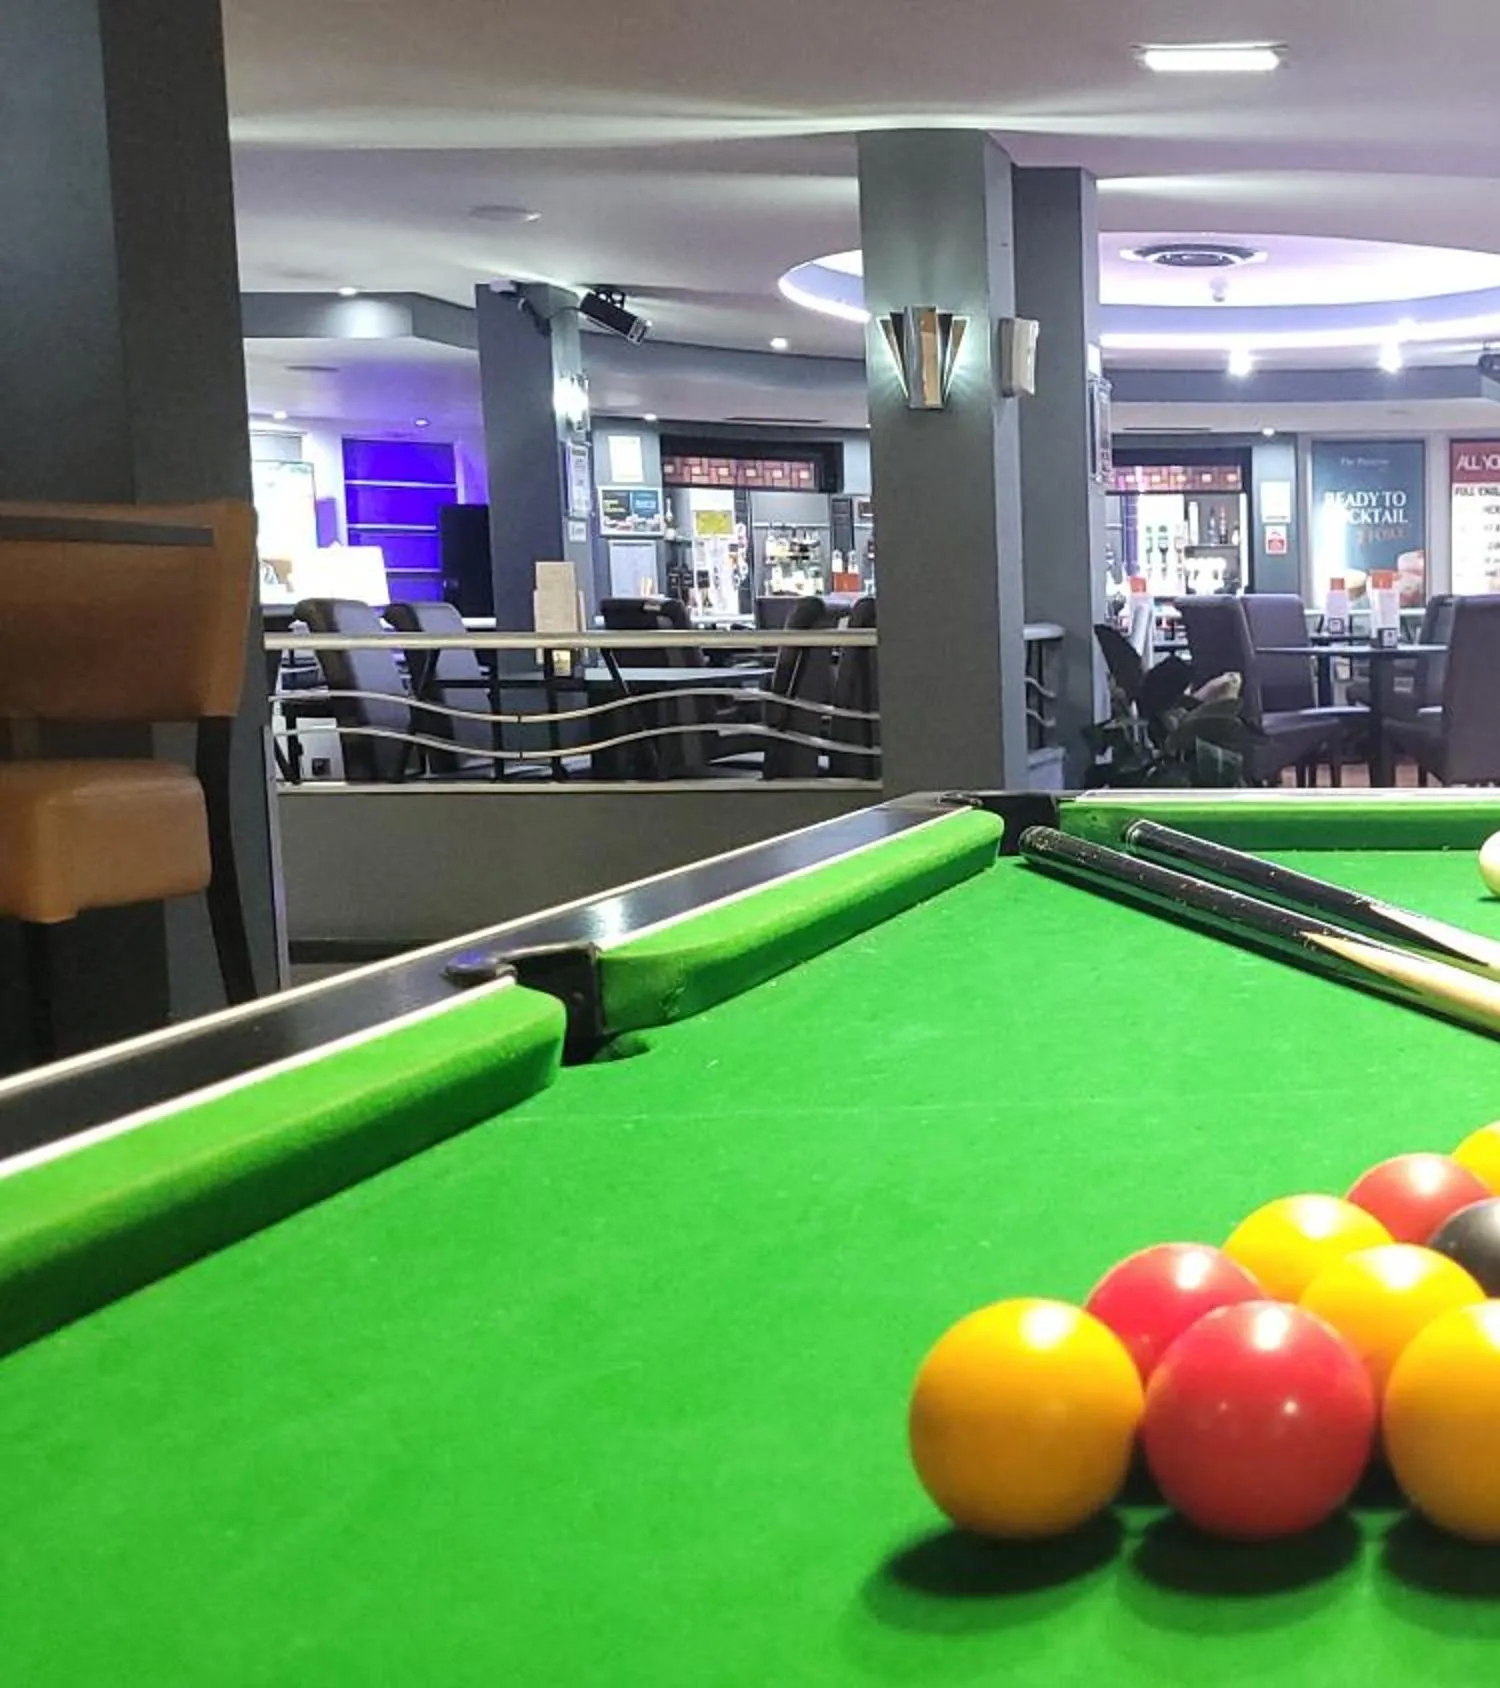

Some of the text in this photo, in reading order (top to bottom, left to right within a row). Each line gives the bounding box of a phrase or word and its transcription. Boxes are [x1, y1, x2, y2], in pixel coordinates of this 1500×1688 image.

[1456, 454, 1481, 471] ALL
[1381, 491, 1407, 507] TO
[1343, 508, 1409, 525] CKTAIL
